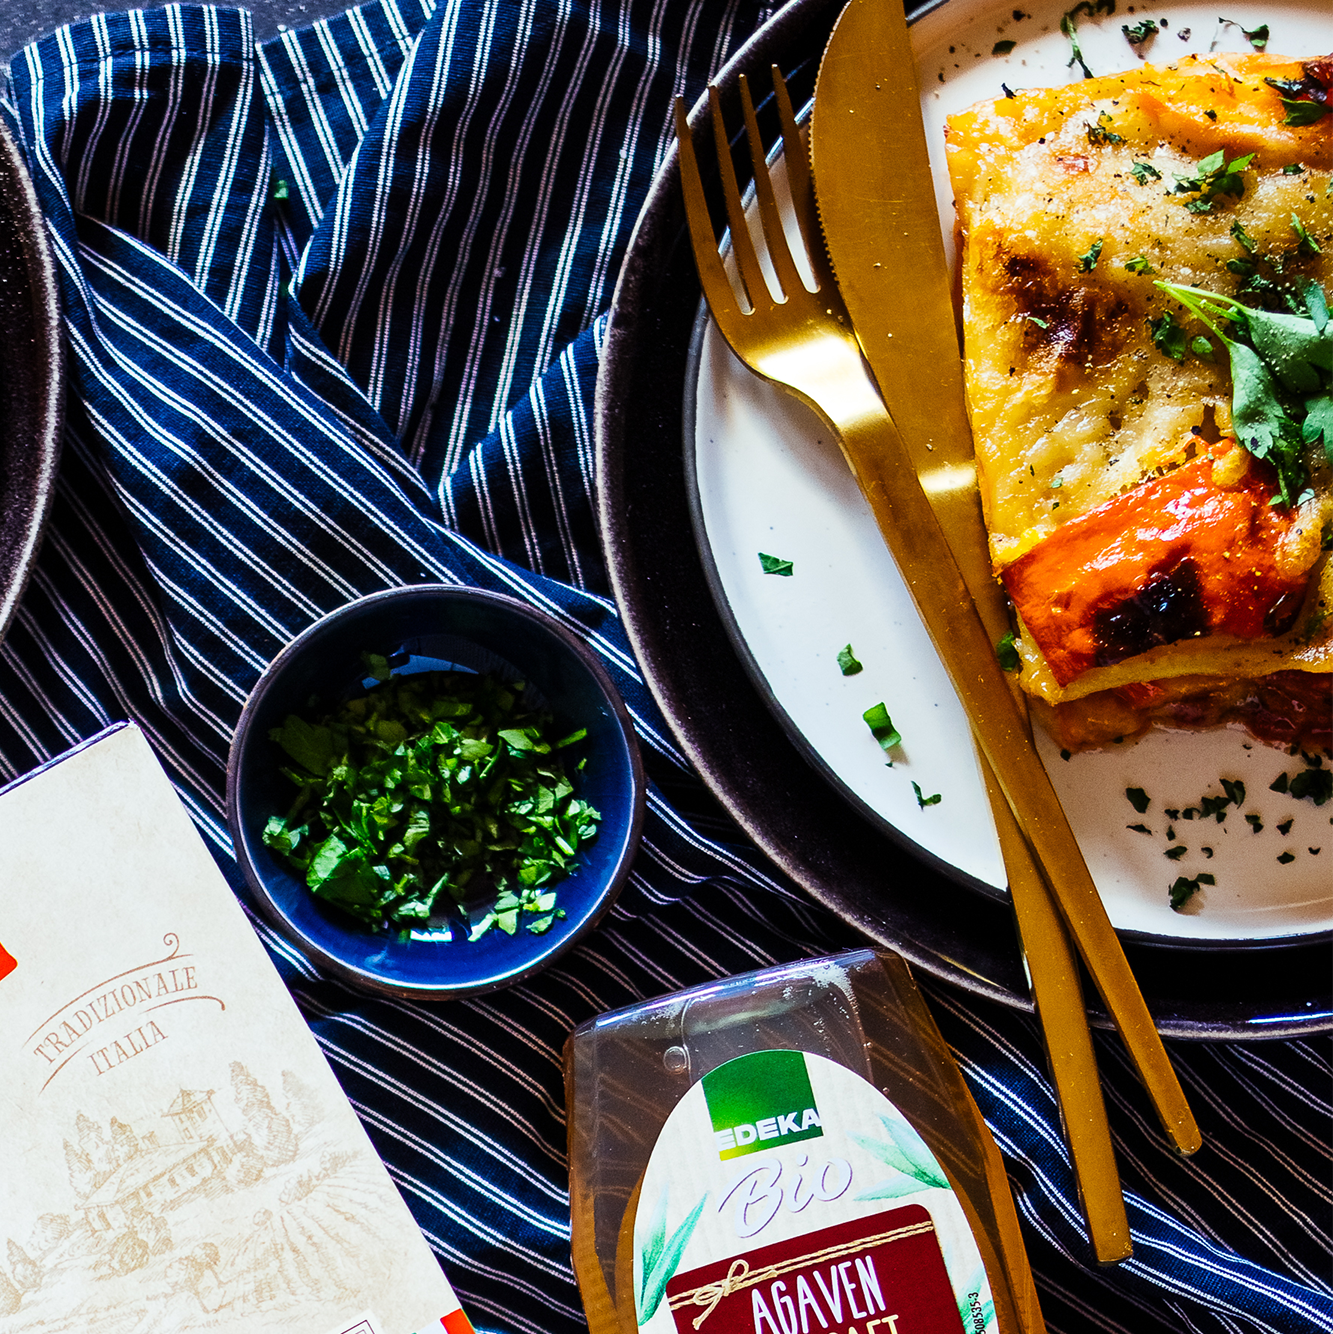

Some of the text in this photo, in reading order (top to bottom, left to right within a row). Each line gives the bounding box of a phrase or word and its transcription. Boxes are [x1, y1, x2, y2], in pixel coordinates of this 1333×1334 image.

[33, 966, 198, 1066] TRADIZIONALE
[86, 1020, 169, 1077] ITALIA
[713, 1107, 822, 1152] EDEKA
[718, 1153, 853, 1239] Bio
[967, 1292, 987, 1334] 508535-3
